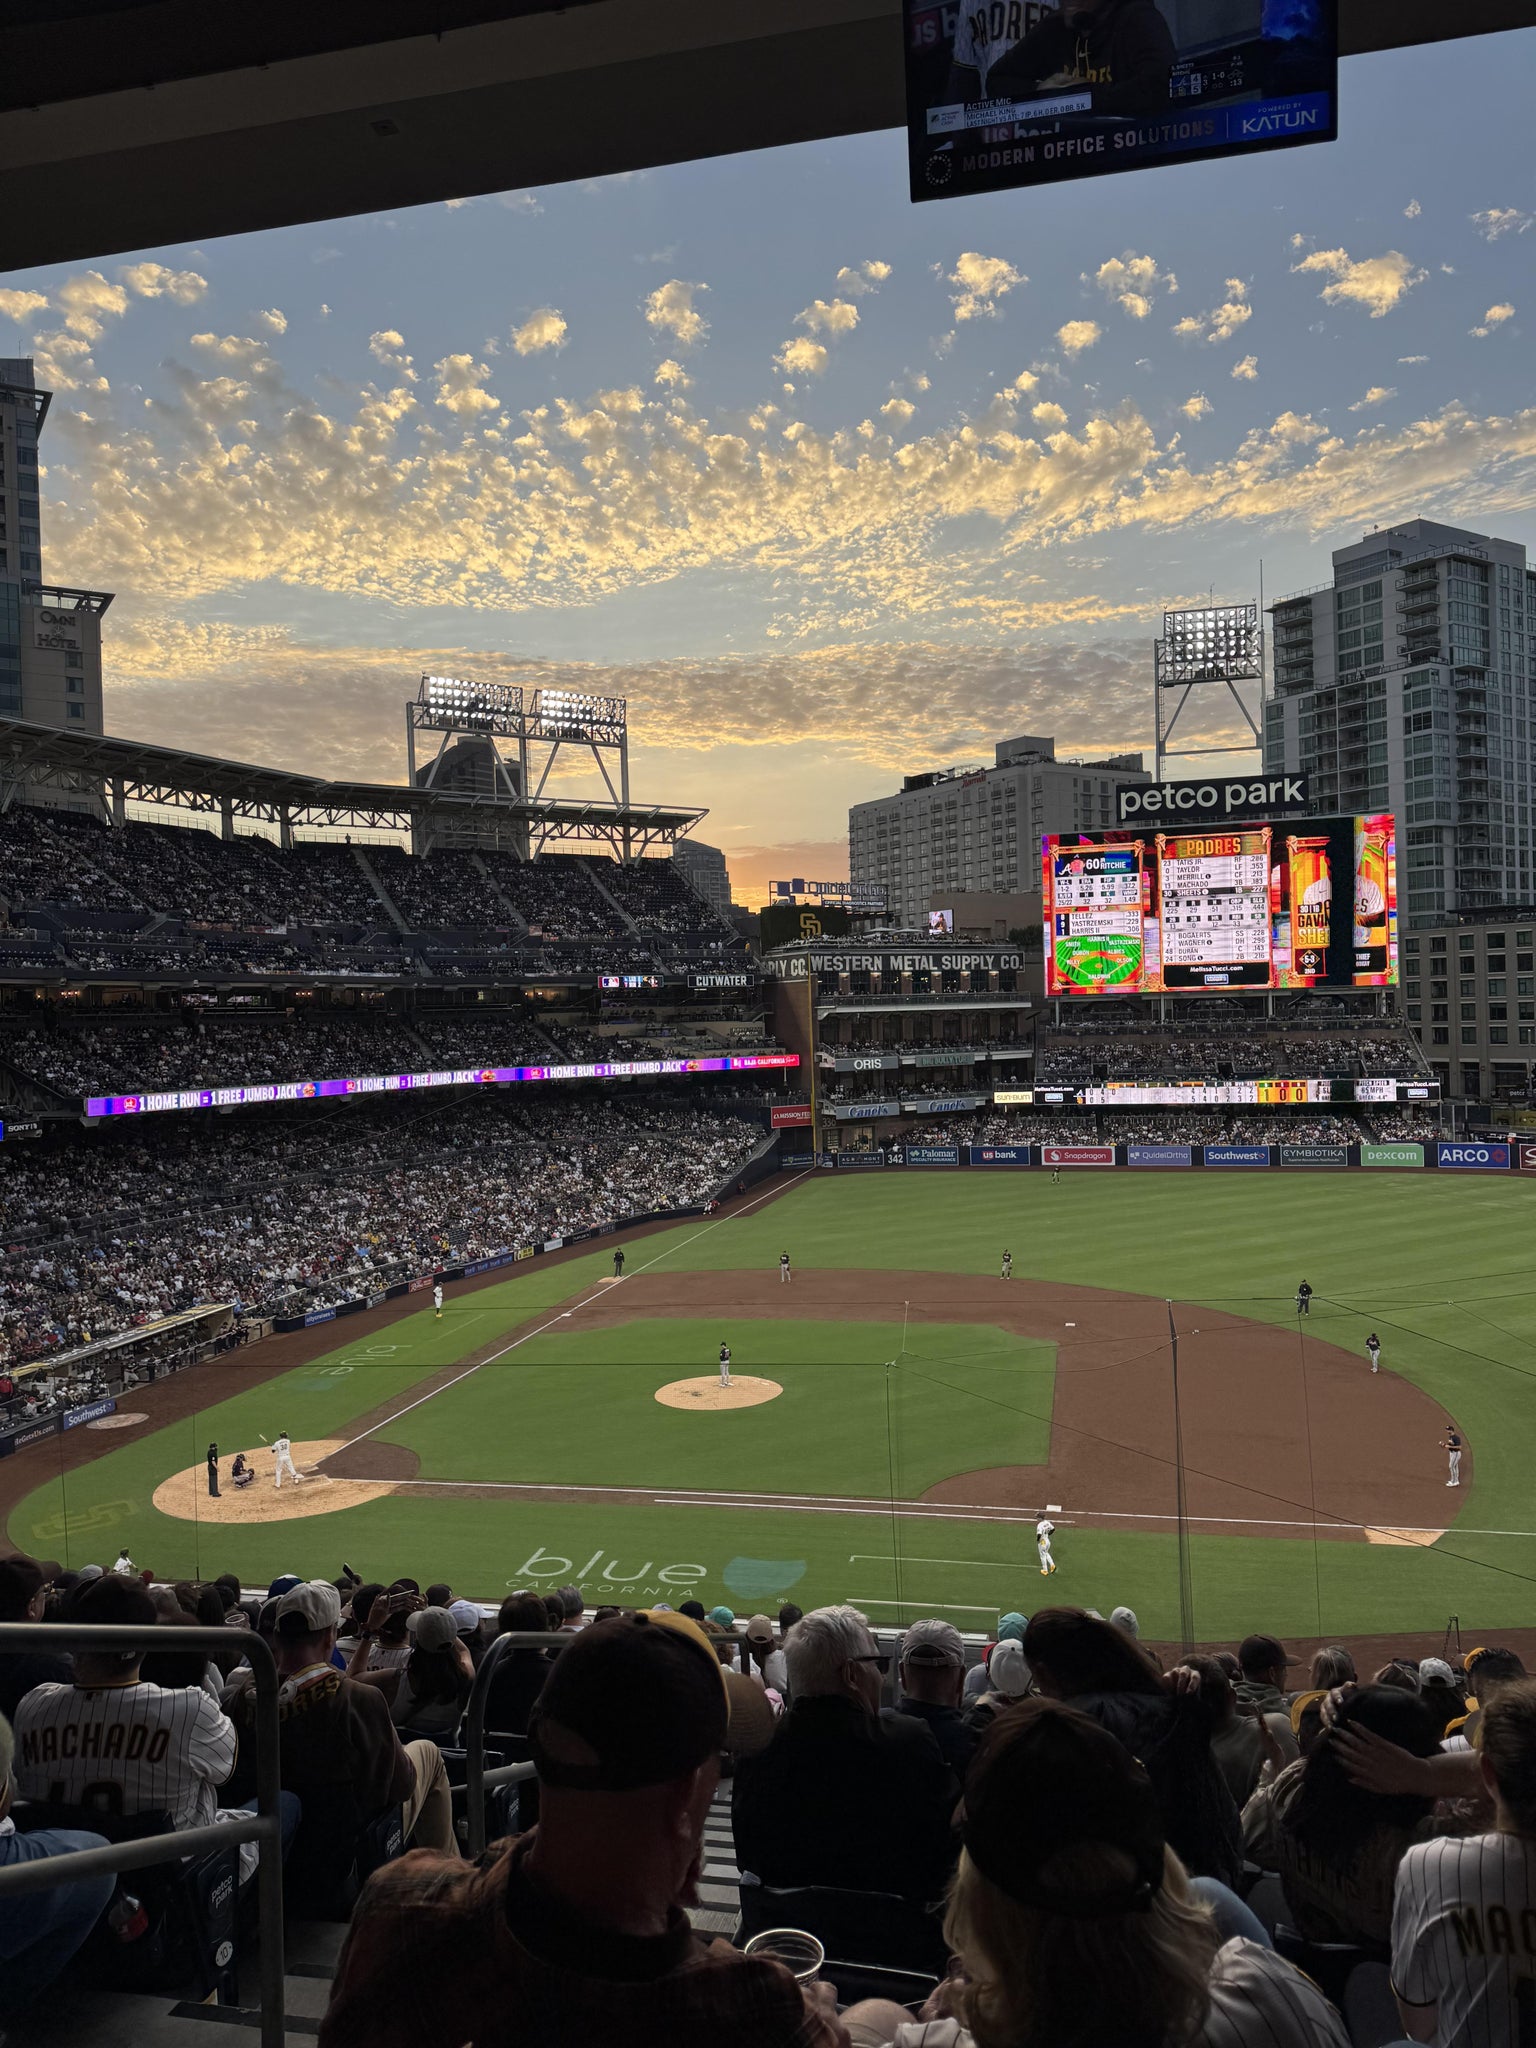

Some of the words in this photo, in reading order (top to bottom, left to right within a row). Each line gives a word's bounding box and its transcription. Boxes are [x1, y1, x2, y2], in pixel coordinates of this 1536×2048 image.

[966, 100, 995, 111] ACTIVE
[996, 97, 1012, 107] MIC
[1258, 103, 1291, 113] POWERED
[967, 110, 998, 121] MICHAEL
[998, 107, 1016, 116] KING
[1242, 109, 1317, 135] KATUN
[962, 147, 1035, 172] MODERN
[1043, 135, 1105, 160] OFFICE
[1113, 120, 1215, 149] SOLUTIONS
[40, 611, 75, 626] OMNI
[37, 633, 80, 650] HOTEL
[1119, 783, 1218, 820] petco
[1225, 777, 1304, 813] park
[1186, 837, 1241, 857] PADRES
[1086, 858, 1100, 870] 60
[1100, 862, 1126, 870] RITCHIE
[1176, 866, 1200, 874] TAYLOR
[1176, 873, 1205, 881] MERRILL
[1176, 881, 1209, 889] MACHADO
[1176, 889, 1202, 897] SHEETS
[1071, 913, 1094, 921] TELLEZ
[1071, 919, 1114, 927] YASTRZEMSKI
[811, 955, 882, 971] WESTERN
[890, 955, 938, 971] METAL
[942, 955, 994, 970] SUPPLY
[1000, 955, 1023, 970] CO.
[1178, 954, 1196, 962] SONG
[790, 958, 808, 977] CO.
[696, 976, 747, 987] CUTWATER
[744, 1059, 756, 1067] BAJA
[757, 1057, 785, 1066] CALIFORNIA
[854, 1058, 882, 1071] ORIS
[544, 1066, 549, 1078] 1
[551, 1065, 575, 1078] HOME
[577, 1064, 596, 1077] RUN
[604, 1063, 609, 1075] 1
[612, 1062, 631, 1074] FREE
[633, 1061, 660, 1073] JUMBO
[357, 1080, 362, 1092] 1
[363, 1078, 385, 1091] HOME
[386, 1076, 400, 1089] RUN
[407, 1075, 412, 1087] 1
[413, 1074, 429, 1086] FREE
[430, 1072, 452, 1085] JUMBO
[139, 1095, 147, 1111] 1
[149, 1093, 178, 1110] HOME
[180, 1092, 200, 1107] RUN
[211, 1090, 218, 1105] 1
[219, 1088, 241, 1104] FREE
[243, 1086, 275, 1103] JUMBO
[849, 1103, 889, 1118] Canel's
[928, 1100, 966, 1113] Canel's
[8, 1123, 31, 1133] SONY
[888, 1153, 904, 1164] 342
[920, 1148, 956, 1158] Palomar
[982, 1150, 994, 1159] us
[994, 1148, 1017, 1158] bank
[1064, 1151, 1107, 1162] Snapdragon
[1142, 1151, 1188, 1161] QuidelOrtho
[1208, 1150, 1259, 1160] Southwest
[1283, 1149, 1345, 1158] CYMBIOTIKA
[1440, 1149, 1490, 1162] ARCO
[68, 1404, 107, 1427] Southwest
[515, 1547, 707, 1585] blue
[22, 1723, 170, 1769] MACHADO
[211, 1875, 233, 1904] petco
[215, 1885, 233, 1910] park
[221, 1946, 229, 1961] 10
